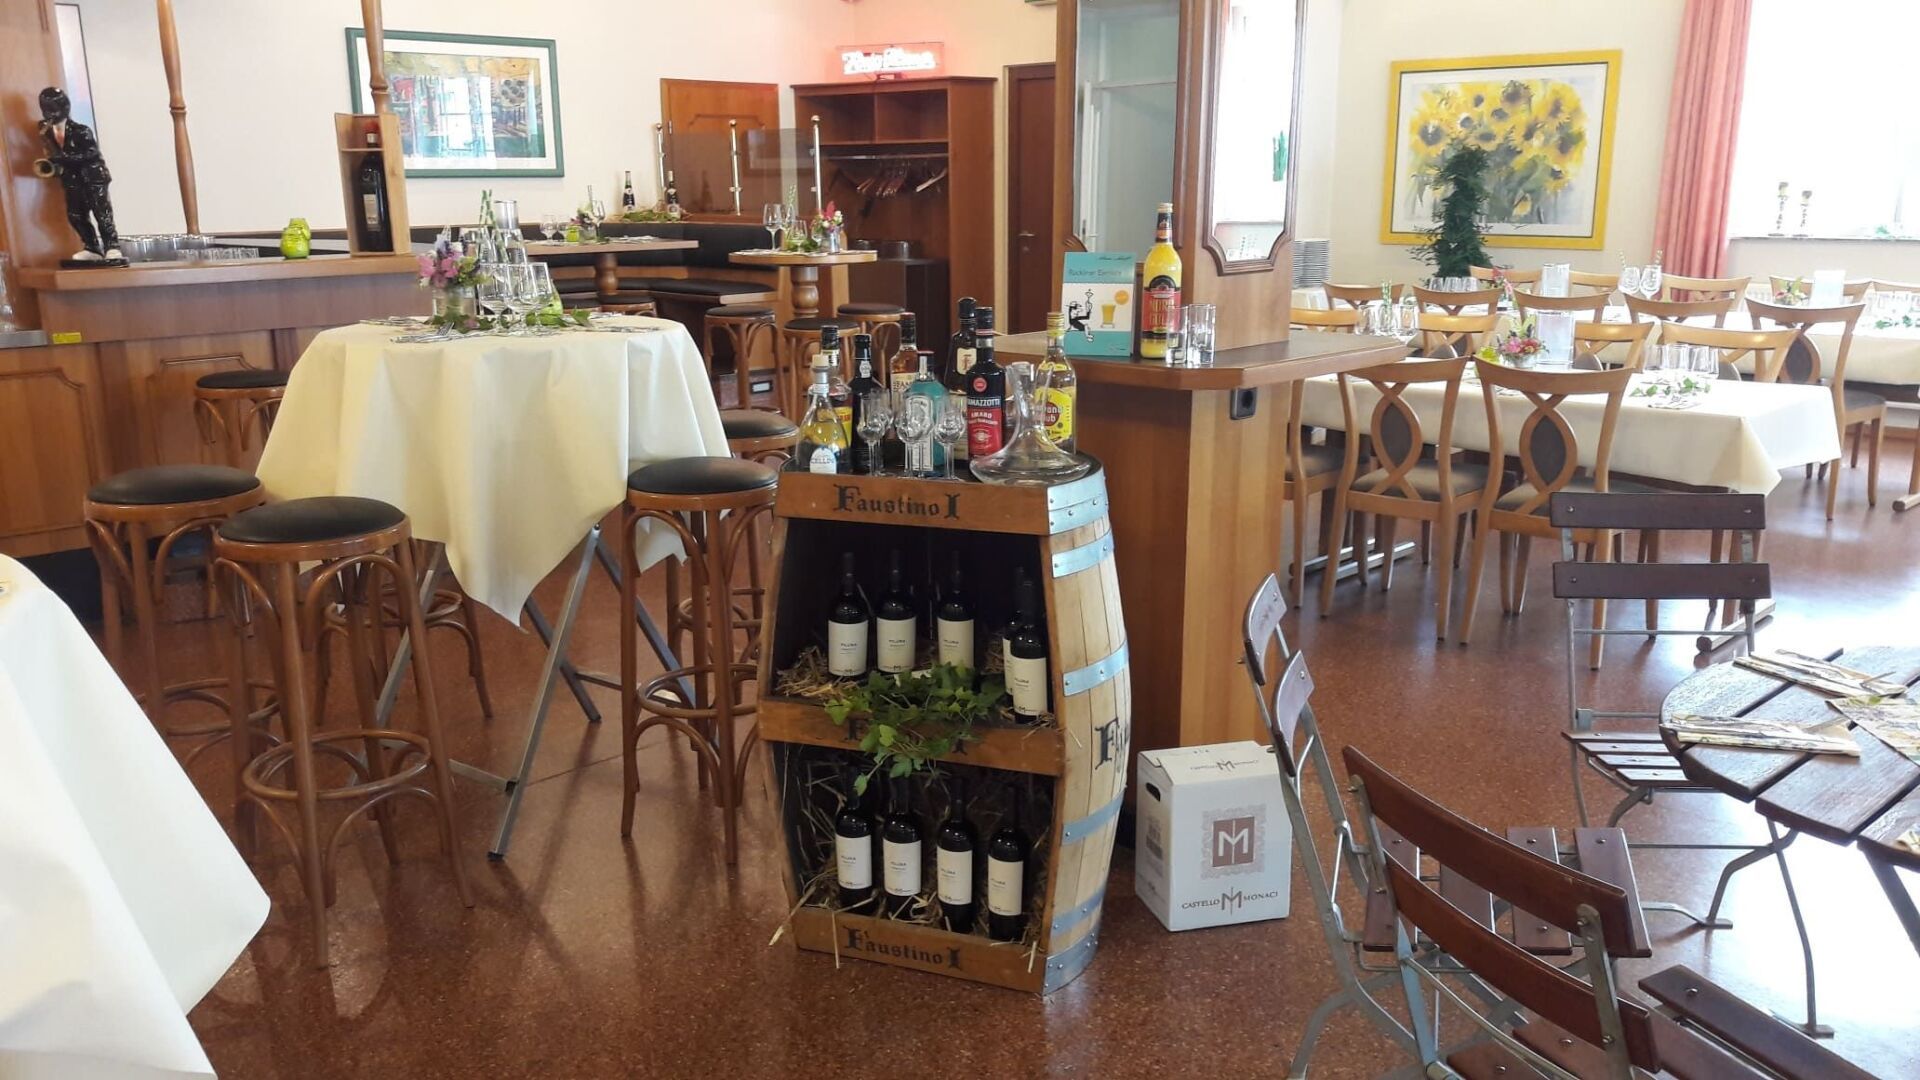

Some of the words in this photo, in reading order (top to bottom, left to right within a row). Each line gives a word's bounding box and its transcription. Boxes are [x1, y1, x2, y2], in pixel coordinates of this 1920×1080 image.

[833, 484, 939, 516] Faustino
[944, 493, 960, 520] I
[1181, 898, 1221, 910] CASTELLO
[1243, 890, 1279, 902] MONACI
[843, 926, 944, 965] Faustino
[946, 946, 963, 971] I
